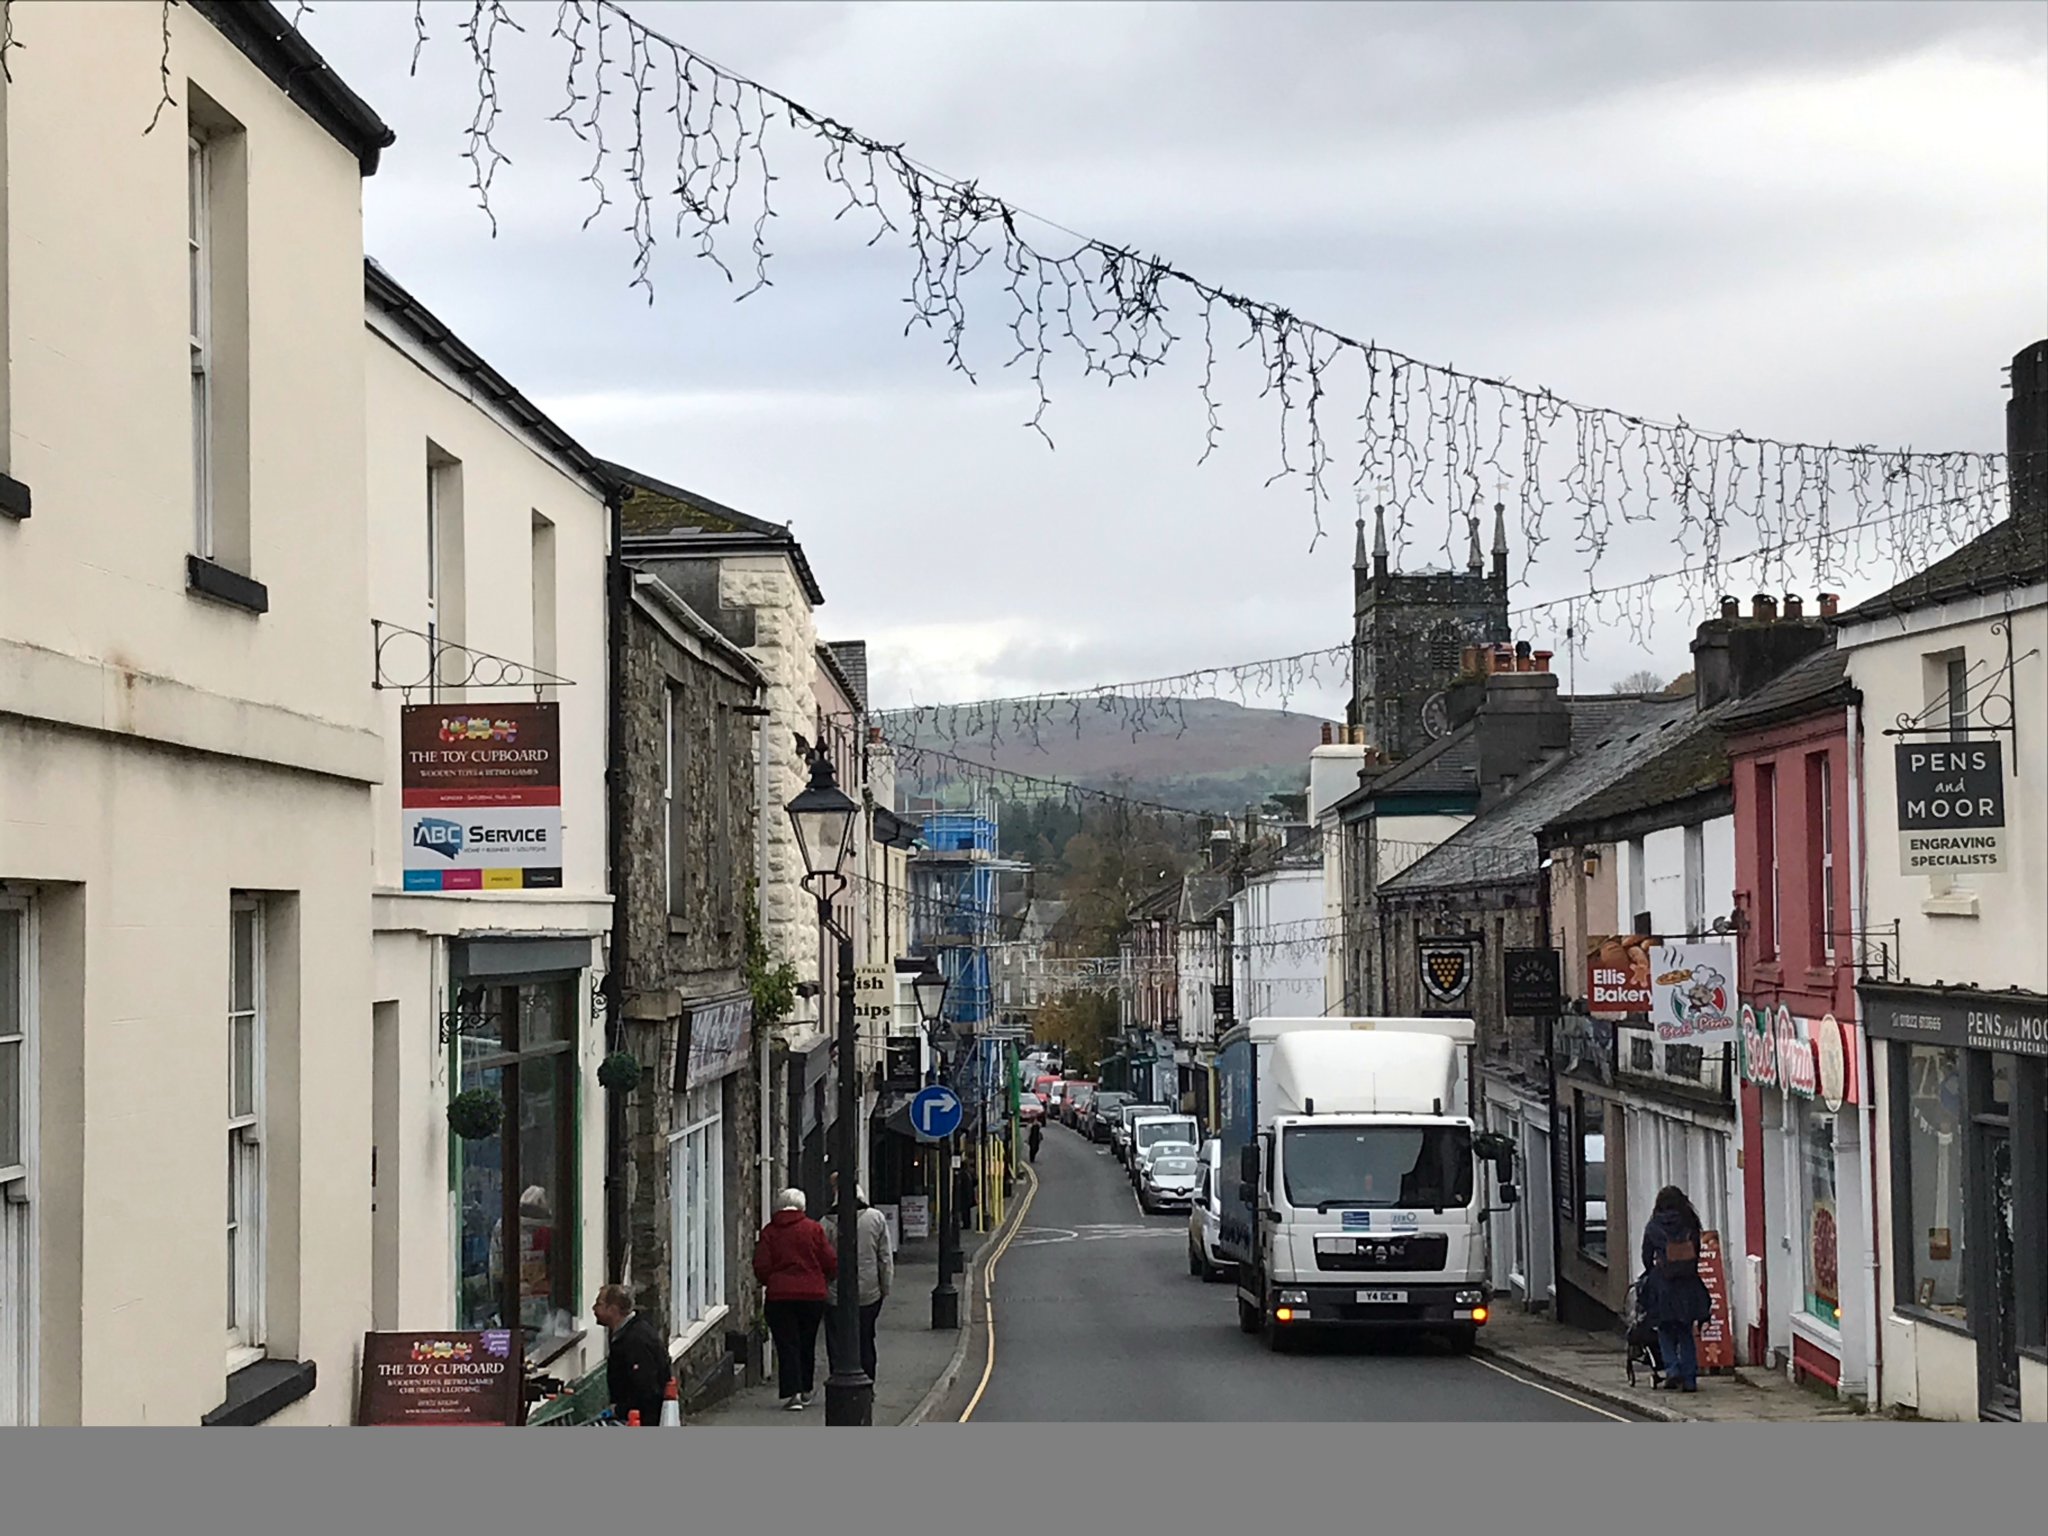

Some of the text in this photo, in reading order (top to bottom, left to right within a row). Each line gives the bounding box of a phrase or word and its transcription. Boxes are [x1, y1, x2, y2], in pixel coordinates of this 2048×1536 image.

[409, 749, 549, 763] THE TOY CUPBOARD
[1911, 752, 1986, 772] PENS
[1935, 777, 1965, 793] and
[1908, 798, 1994, 818] MOOR
[415, 826, 461, 844] ABC
[1910, 837, 1996, 850] ENGRAVING
[1911, 854, 1997, 867] SPECIALISTS
[856, 977, 884, 990] ish
[1594, 969, 1626, 985] Ellis
[1594, 986, 1652, 1005] Bakery
[854, 1003, 891, 1020] hips
[1967, 1011, 2001, 1036] PENS
[1742, 1004, 1776, 1085] Best
[1968, 1035, 2010, 1050] ENGRAVING
[1358, 1245, 1405, 1256] MAN
[378, 1362, 504, 1376] THE TOY CUPBOARD
[387, 1379, 421, 1387] WOODEN
